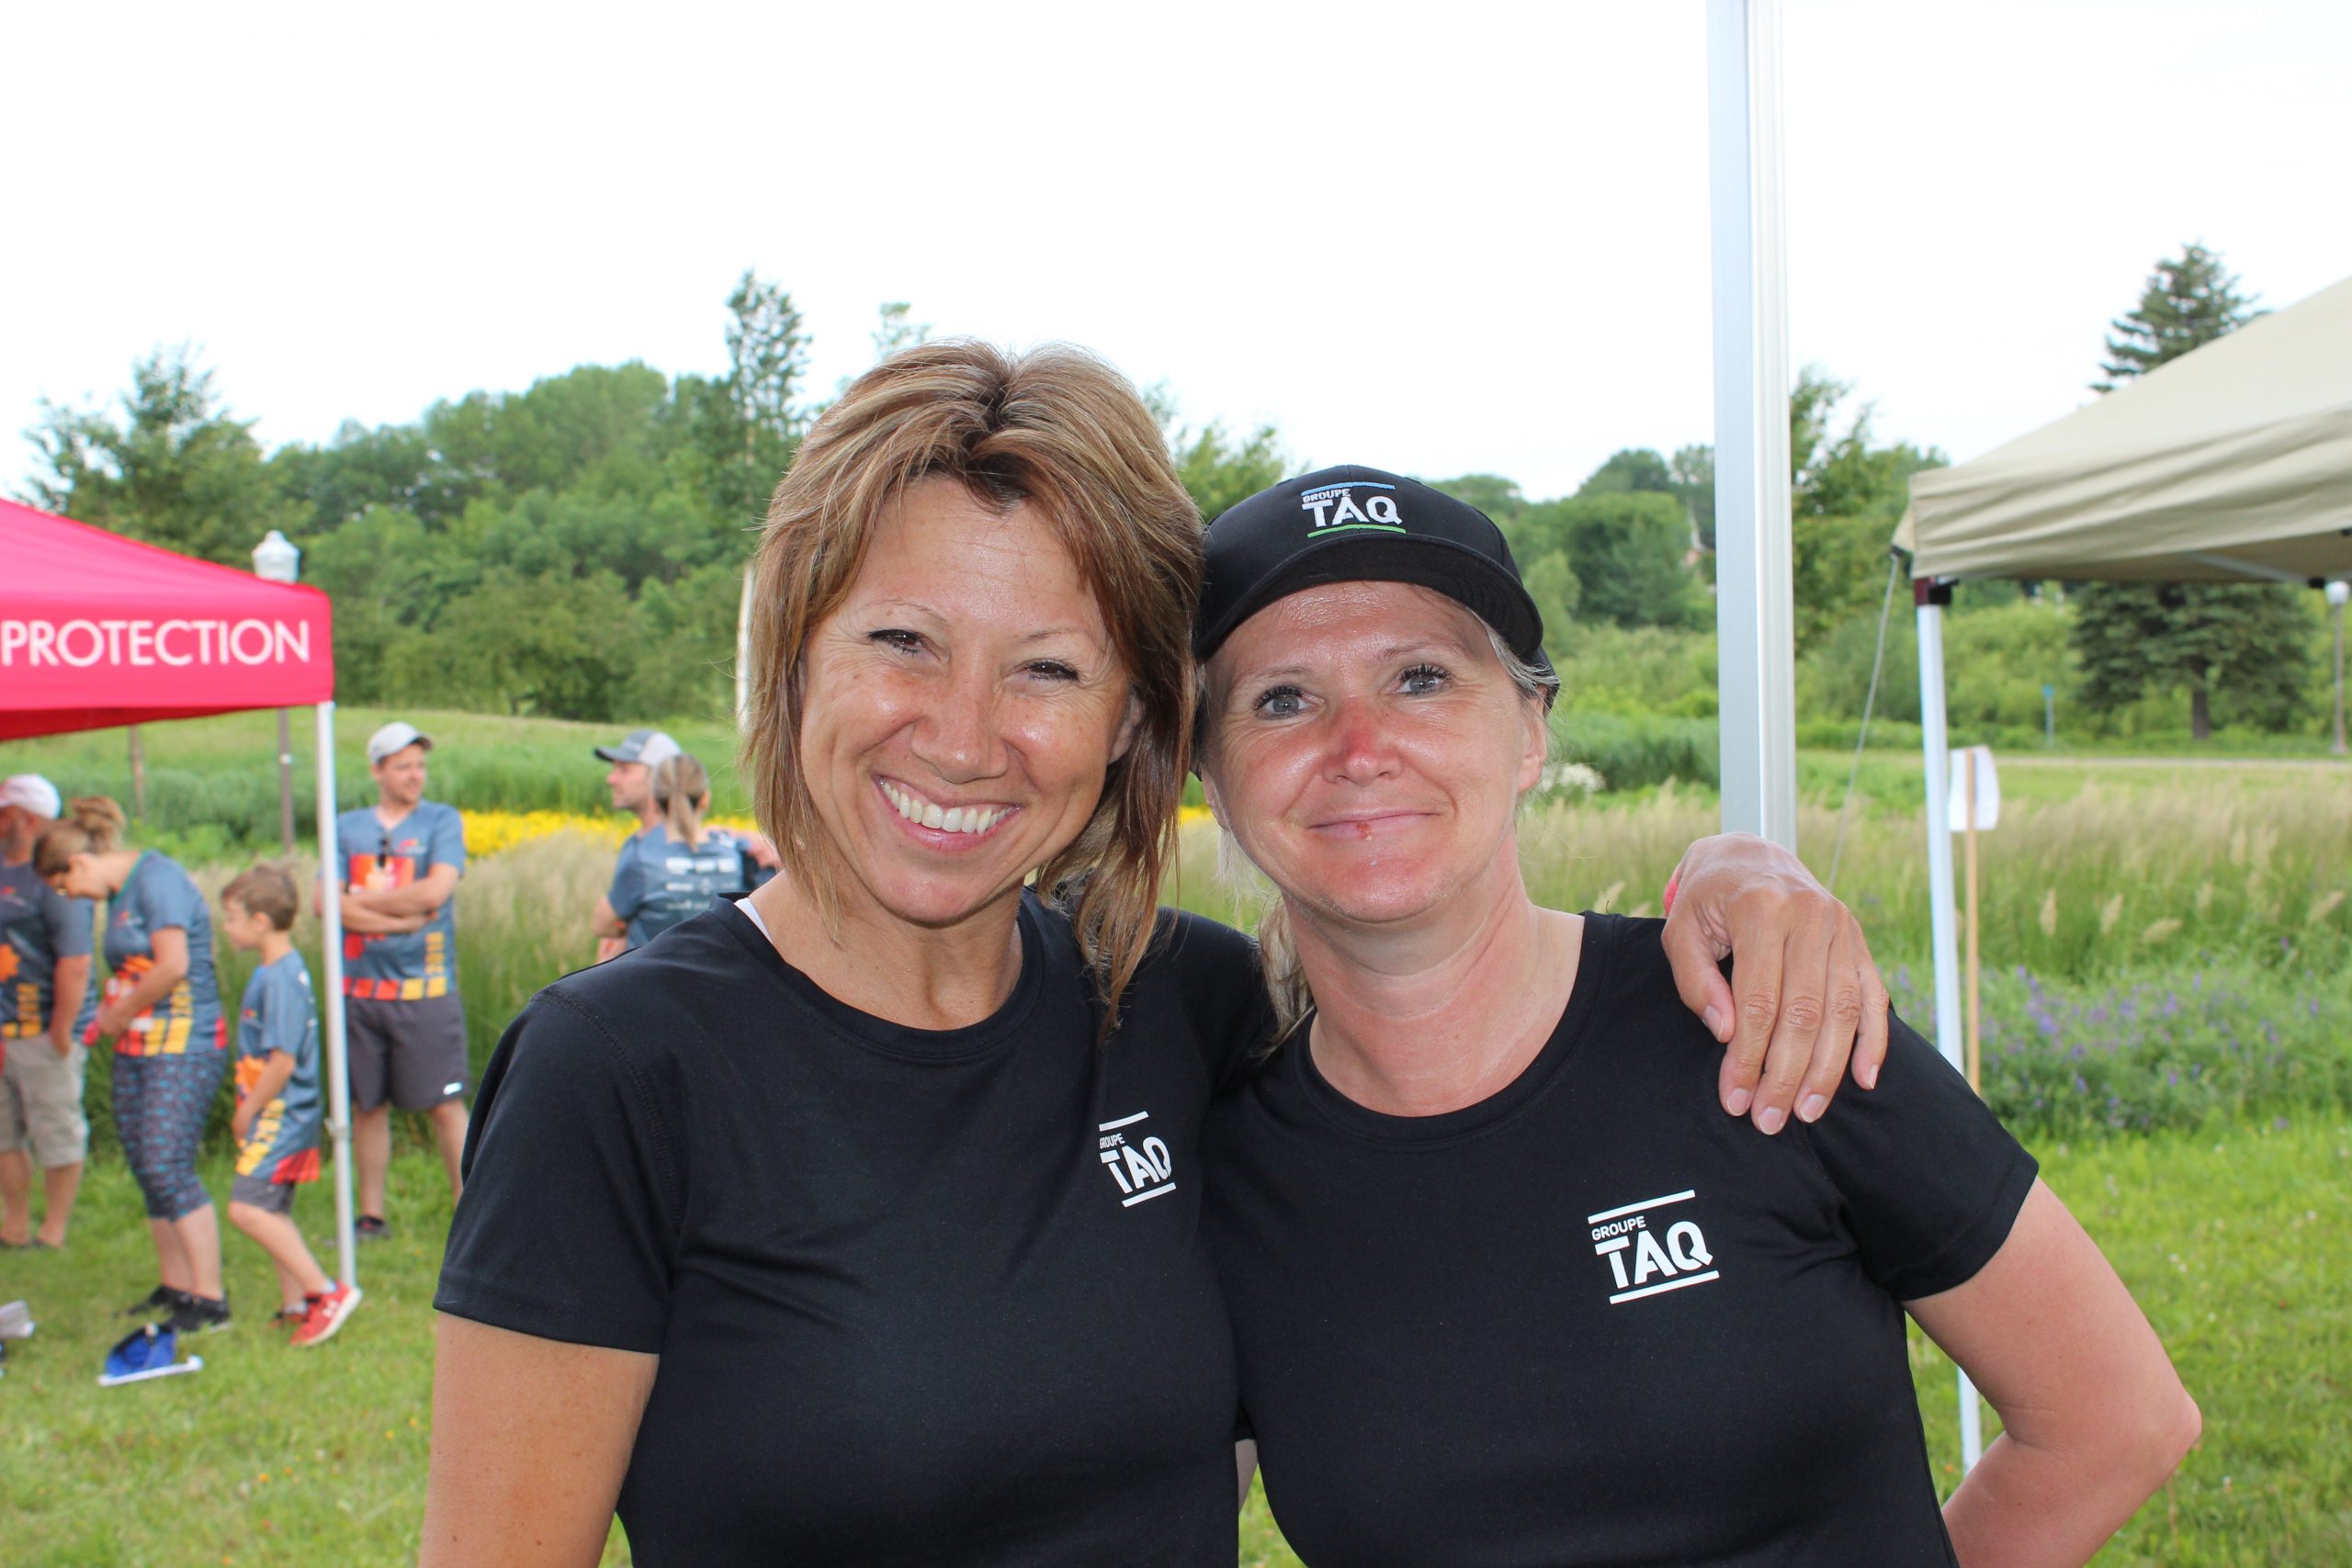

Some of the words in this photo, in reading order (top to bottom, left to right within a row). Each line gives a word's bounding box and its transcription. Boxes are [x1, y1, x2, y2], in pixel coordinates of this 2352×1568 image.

[1302, 495, 1403, 528] TAQ
[1303, 488, 1351, 503] GROUPE
[1, 619, 310, 667] PROTECTION
[1100, 1136, 1172, 1194] TAQ
[1591, 1215, 1646, 1241] GROUPE
[1594, 1221, 1713, 1289] TAQ
